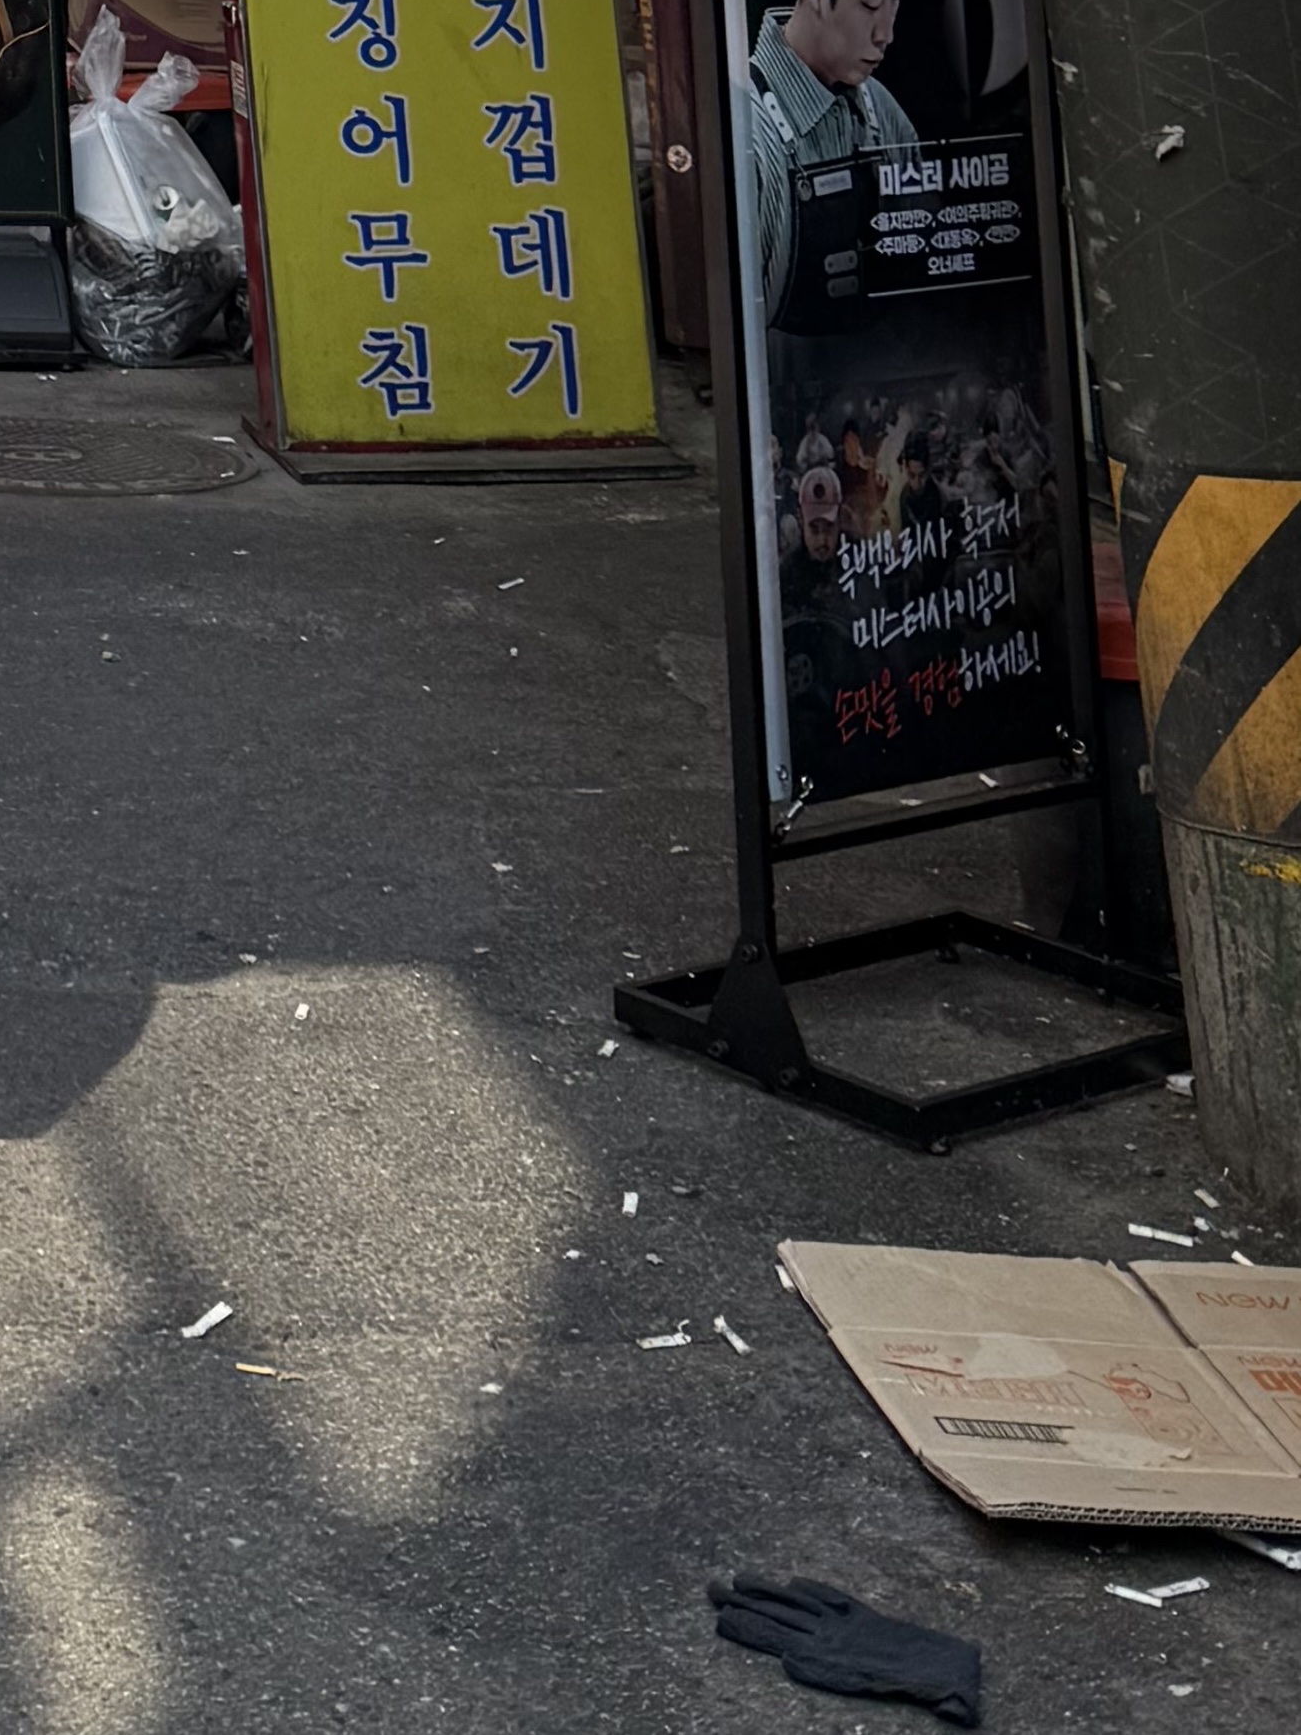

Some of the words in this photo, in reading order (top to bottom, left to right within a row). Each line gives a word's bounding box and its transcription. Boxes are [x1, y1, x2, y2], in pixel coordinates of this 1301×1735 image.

[878, 159, 944, 196] 미스터
[949, 153, 1010, 190] 사이공
[837, 517, 953, 600] 흑백요리사
[960, 492, 1021, 560] 흑수저
[852, 564, 1016, 649] 미스터사이공의
[835, 667, 902, 744] 손맛을
